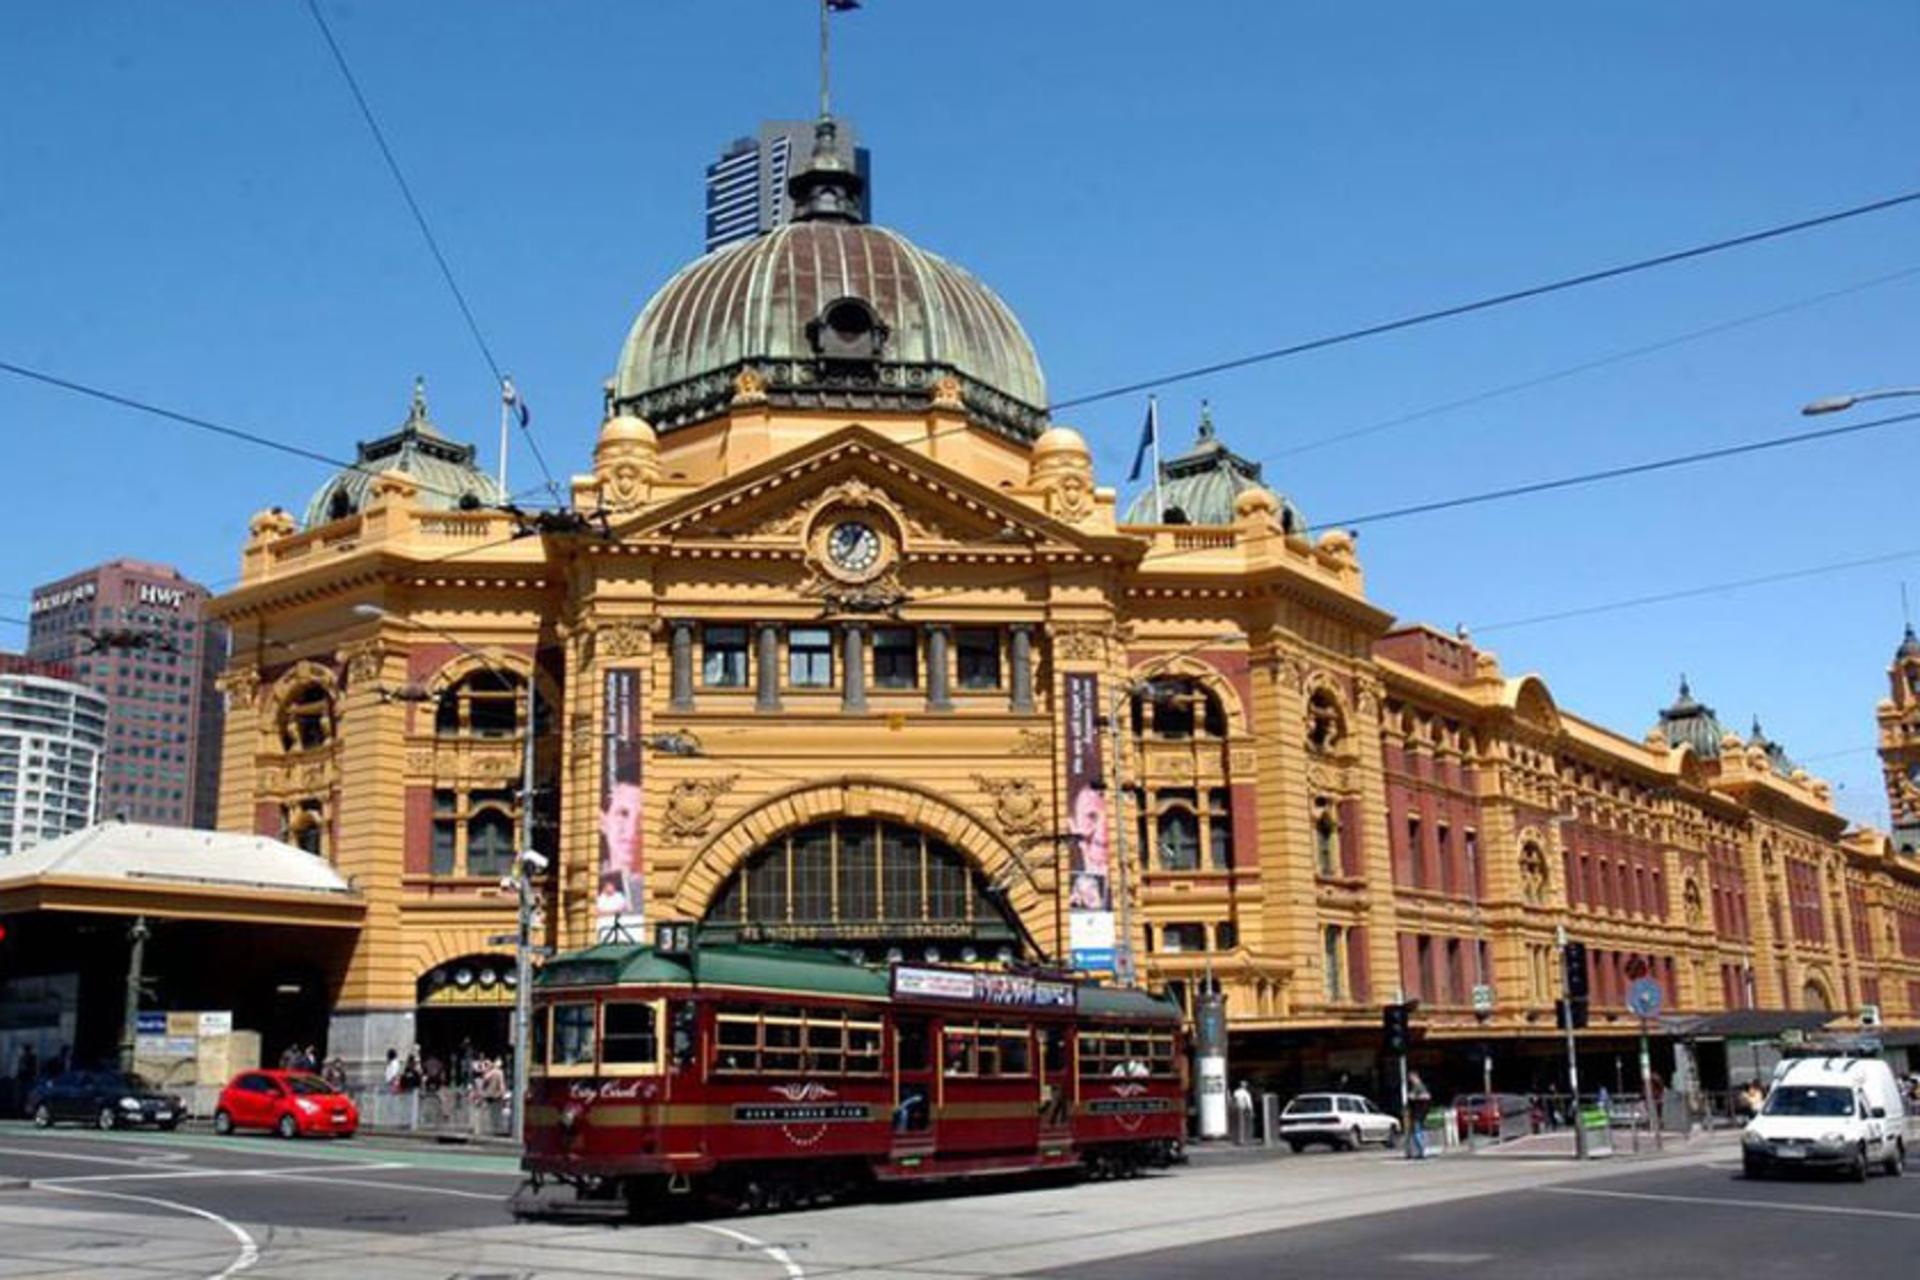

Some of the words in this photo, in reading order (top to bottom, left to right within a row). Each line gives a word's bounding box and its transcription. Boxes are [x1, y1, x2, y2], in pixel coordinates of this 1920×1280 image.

[140, 584, 184, 606] HWT
[661, 927, 689, 950] 35
[907, 924, 973, 939] STATION
